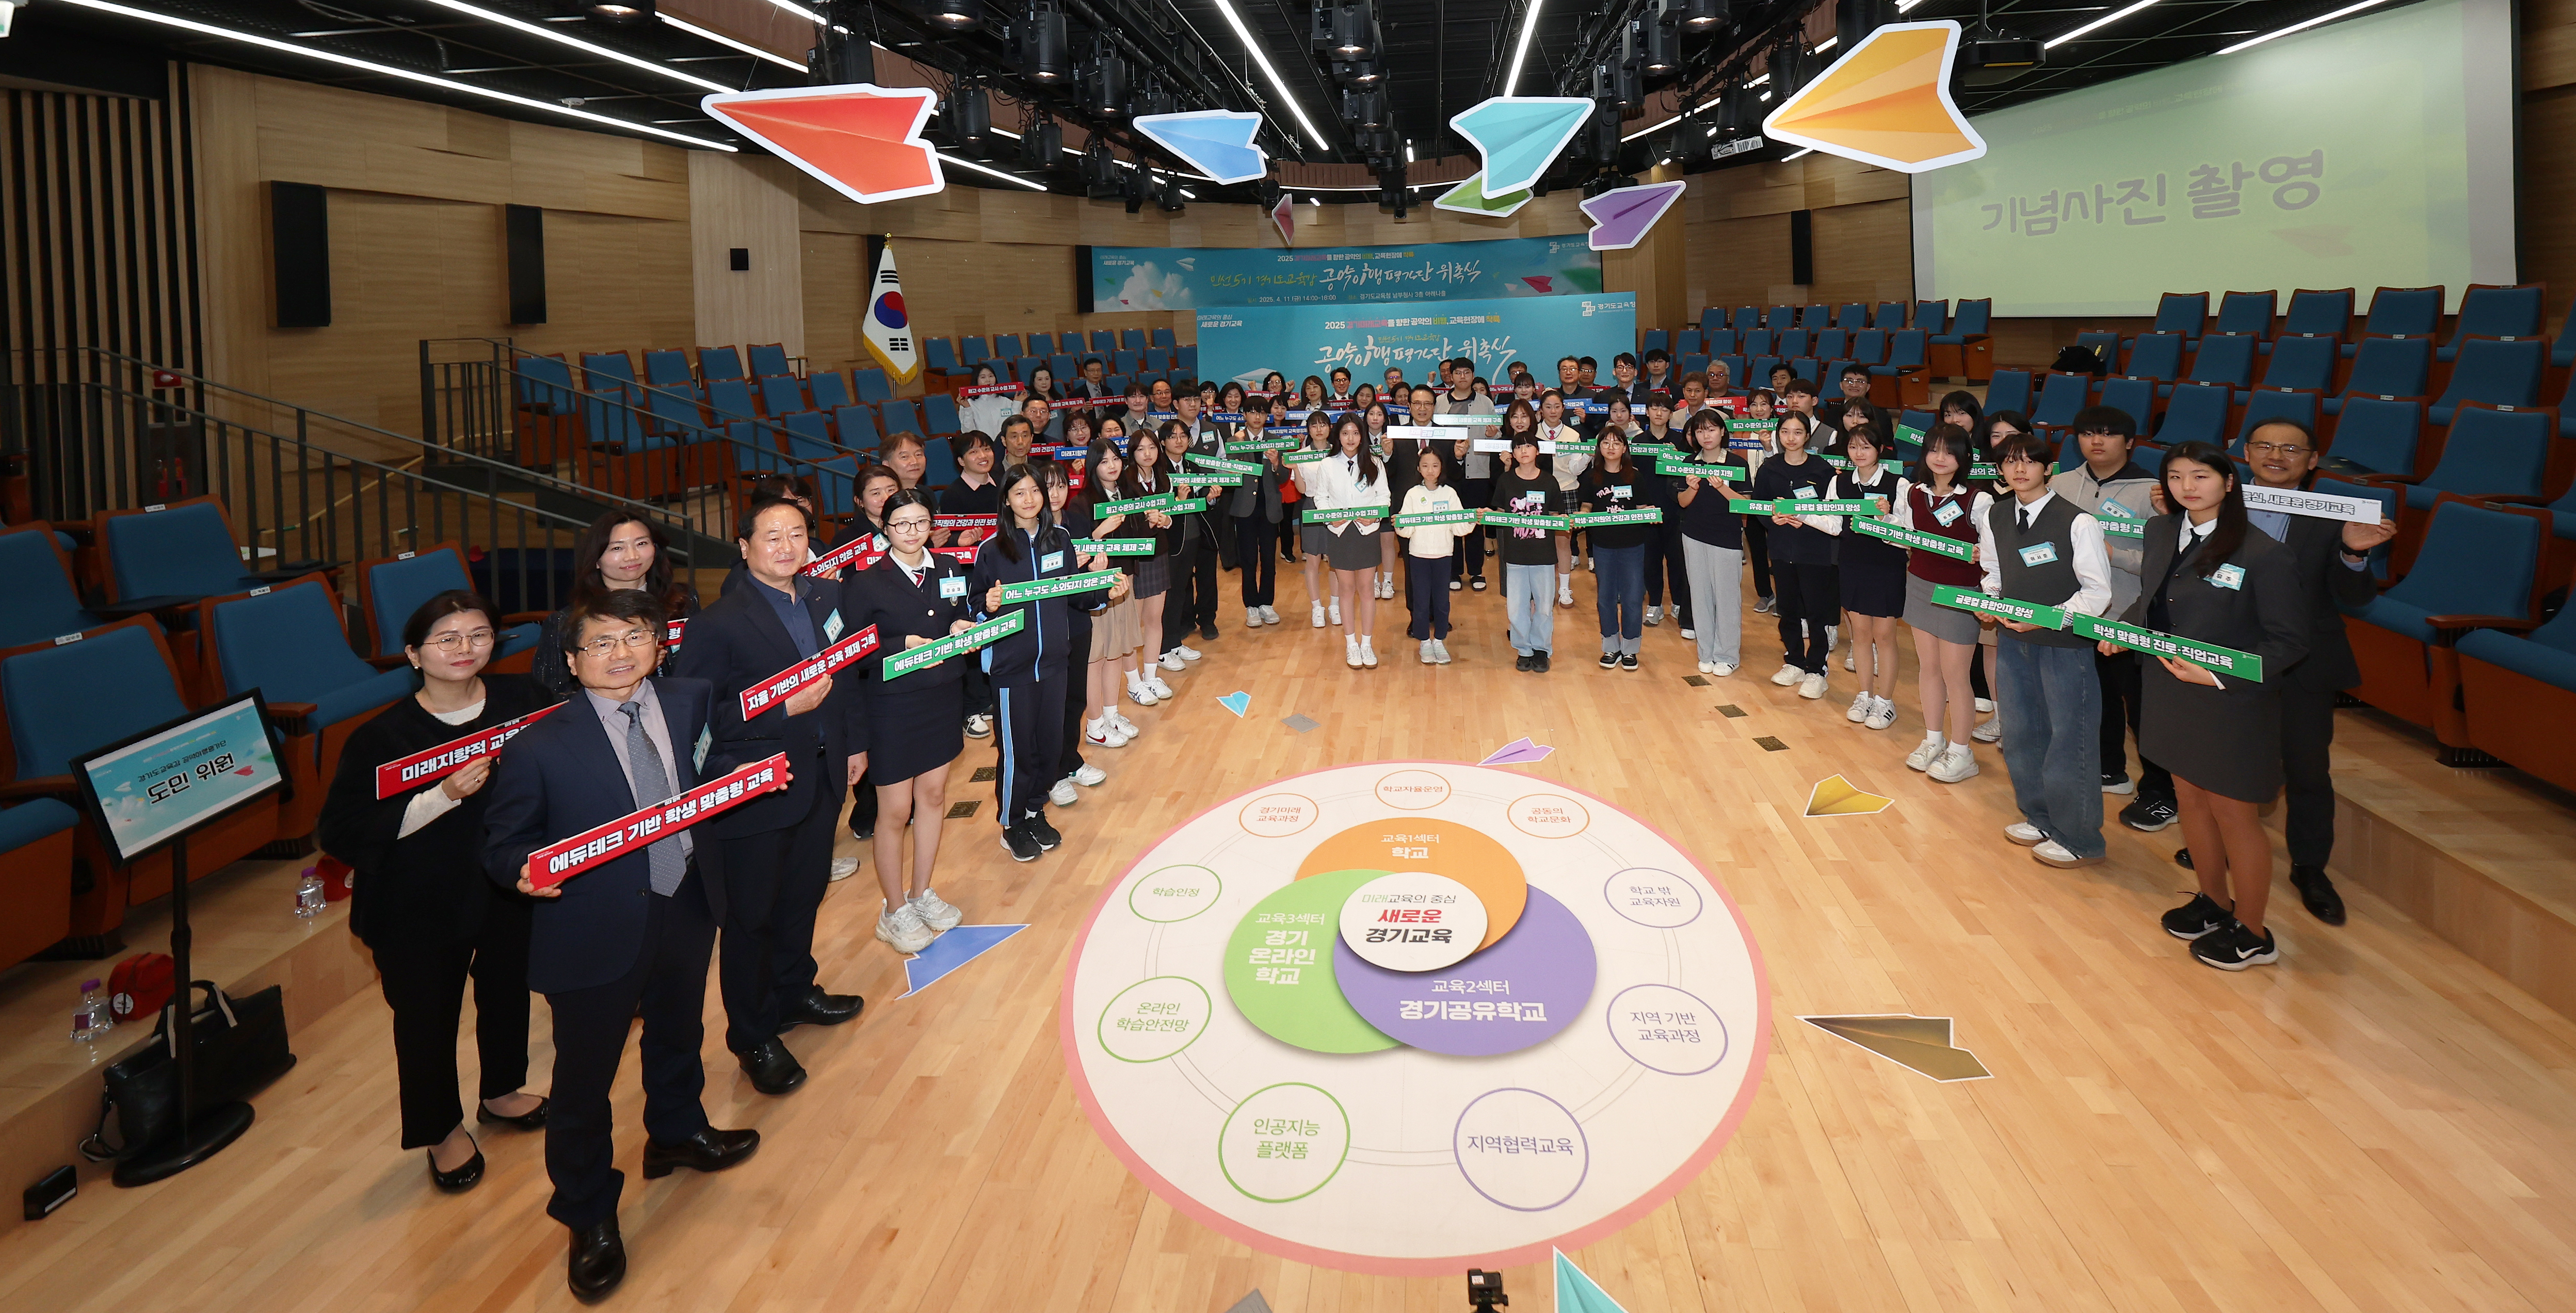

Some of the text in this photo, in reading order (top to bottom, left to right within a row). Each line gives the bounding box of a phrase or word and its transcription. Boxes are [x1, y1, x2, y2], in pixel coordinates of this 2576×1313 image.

[1981, 149, 2323, 237] 기념사진 촬영
[1410, 317, 1431, 326] 공약의
[1450, 316, 1485, 324] 교육현장에
[1205, 459, 1220, 467] 맞춤형
[1678, 466, 1694, 474] 수준의
[1695, 467, 1706, 475] 교사
[1720, 469, 1732, 477] 지원
[1118, 504, 1134, 513] 수준의
[1135, 502, 1145, 511] 교사
[1846, 504, 1860, 512] 양성
[2268, 494, 2355, 515] 새로운 경기교육
[1574, 515, 1611, 524] 학생·교직원의
[1859, 521, 1965, 556] 에듀테크 기반 학생 맞춤형 교육
[840, 548, 853, 564] 않은
[854, 541, 867, 556] 교육
[957, 550, 972, 560] 구축
[1082, 543, 1152, 553] 새로운 교육 체제 구축
[1005, 574, 1114, 599] 어느 누구도 소외되지 않은 교육
[1955, 594, 2034, 619] 글로컬 융합인재 양성
[894, 619, 1017, 672] 에듀테크 기반 학생 맞춤형 교육
[2093, 623, 2233, 670] 학생 맞춤형 진로·직업교육
[747, 633, 876, 711] 자율 기반의 새로운 교육 체제 구축
[401, 739, 486, 782] 미래지향적
[147, 752, 235, 805] 도민 위원
[1383, 785, 1443, 793] 학교자율운영
[1256, 814, 1298, 823] 교육과정
[1531, 807, 1563, 815] 공동의
[549, 768, 774, 874] 에듀테크 기반 학생 맞춤형 교육
[1527, 815, 1571, 824] 학교문화
[1381, 834, 1440, 844] 교육1섹터
[1391, 846, 1429, 860] 학교
[1152, 887, 1200, 898] 학습인정
[1629, 885, 1671, 896] 학교 밖
[1361, 894, 1457, 904] 미래교육의 중심
[1630, 897, 1681, 907] 교육자원
[1255, 913, 1325, 926] 교육3섹터
[1377, 909, 1442, 924] 새로운
[1265, 929, 1307, 946] 경기
[1365, 928, 1453, 944] 경기교육
[1248, 948, 1316, 965] 온라인
[1255, 967, 1300, 985] 학교
[1431, 979, 1510, 995] 교육2섹터
[1136, 1002, 1181, 1015] 온라인
[1399, 1000, 1548, 1023] 경기공유학교
[1116, 1017, 1189, 1032] 학습안전망
[1631, 1011, 1696, 1026] 지역 기반
[1638, 1029, 1701, 1043] 교육과정
[1253, 1118, 1321, 1137] 인공지능
[1256, 1141, 1309, 1160] 플랫폼
[1467, 1135, 1574, 1155] 지역협력교육
